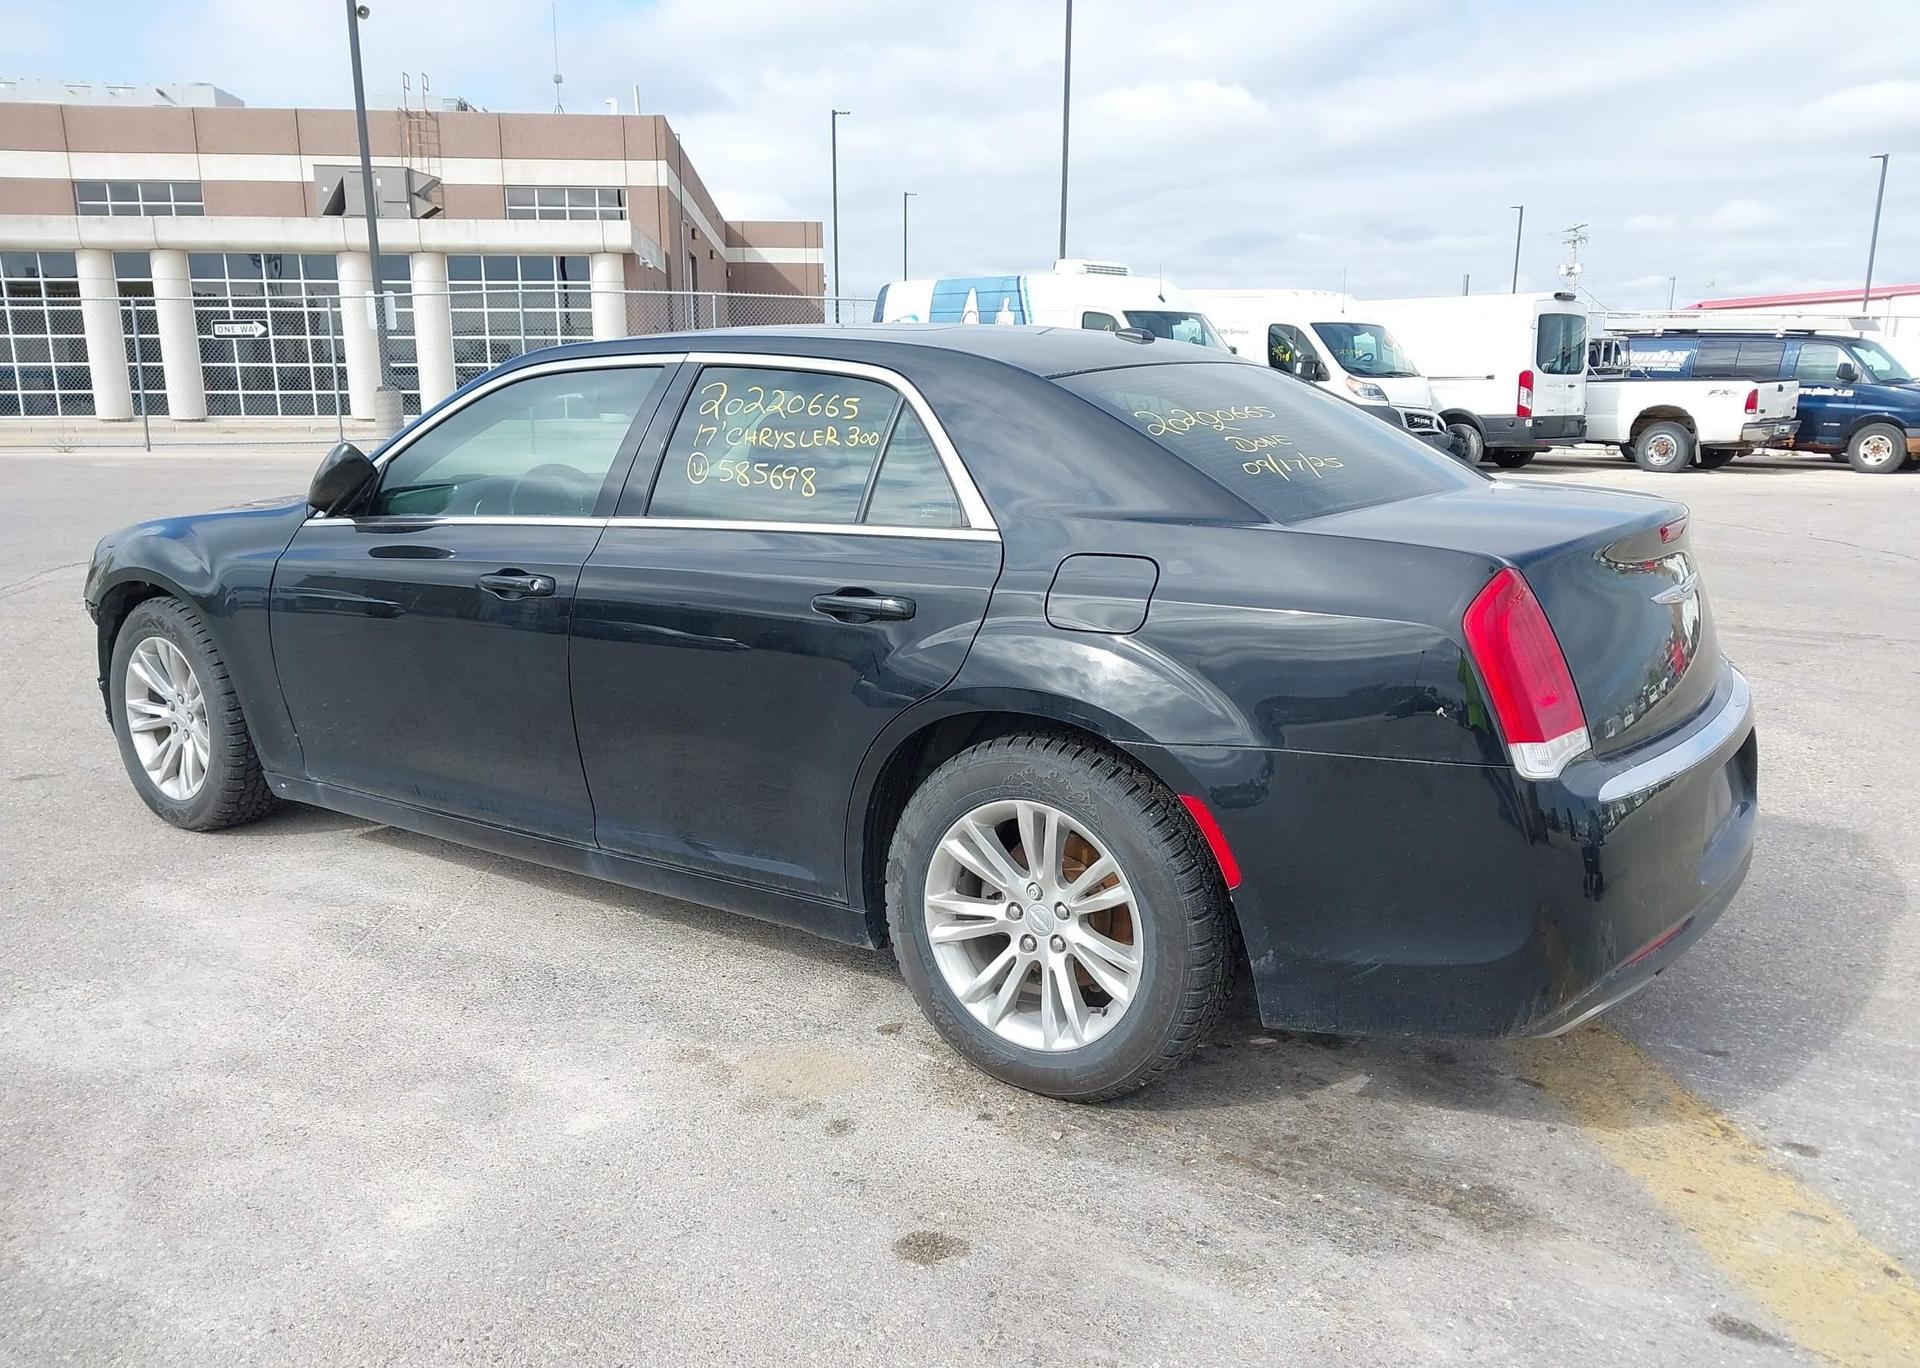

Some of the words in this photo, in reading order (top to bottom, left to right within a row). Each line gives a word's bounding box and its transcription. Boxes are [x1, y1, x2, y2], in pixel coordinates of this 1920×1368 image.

[217, 325, 237, 334] ONE
[239, 325, 259, 334] WAY
[699, 382, 861, 420] 20220665
[845, 426, 880, 446] 300
[1134, 406, 1276, 436] 20220665
[1413, 417, 1430, 425] RAM
[718, 460, 816, 497] 585698
[1242, 451, 1346, 482] 09/17/25
